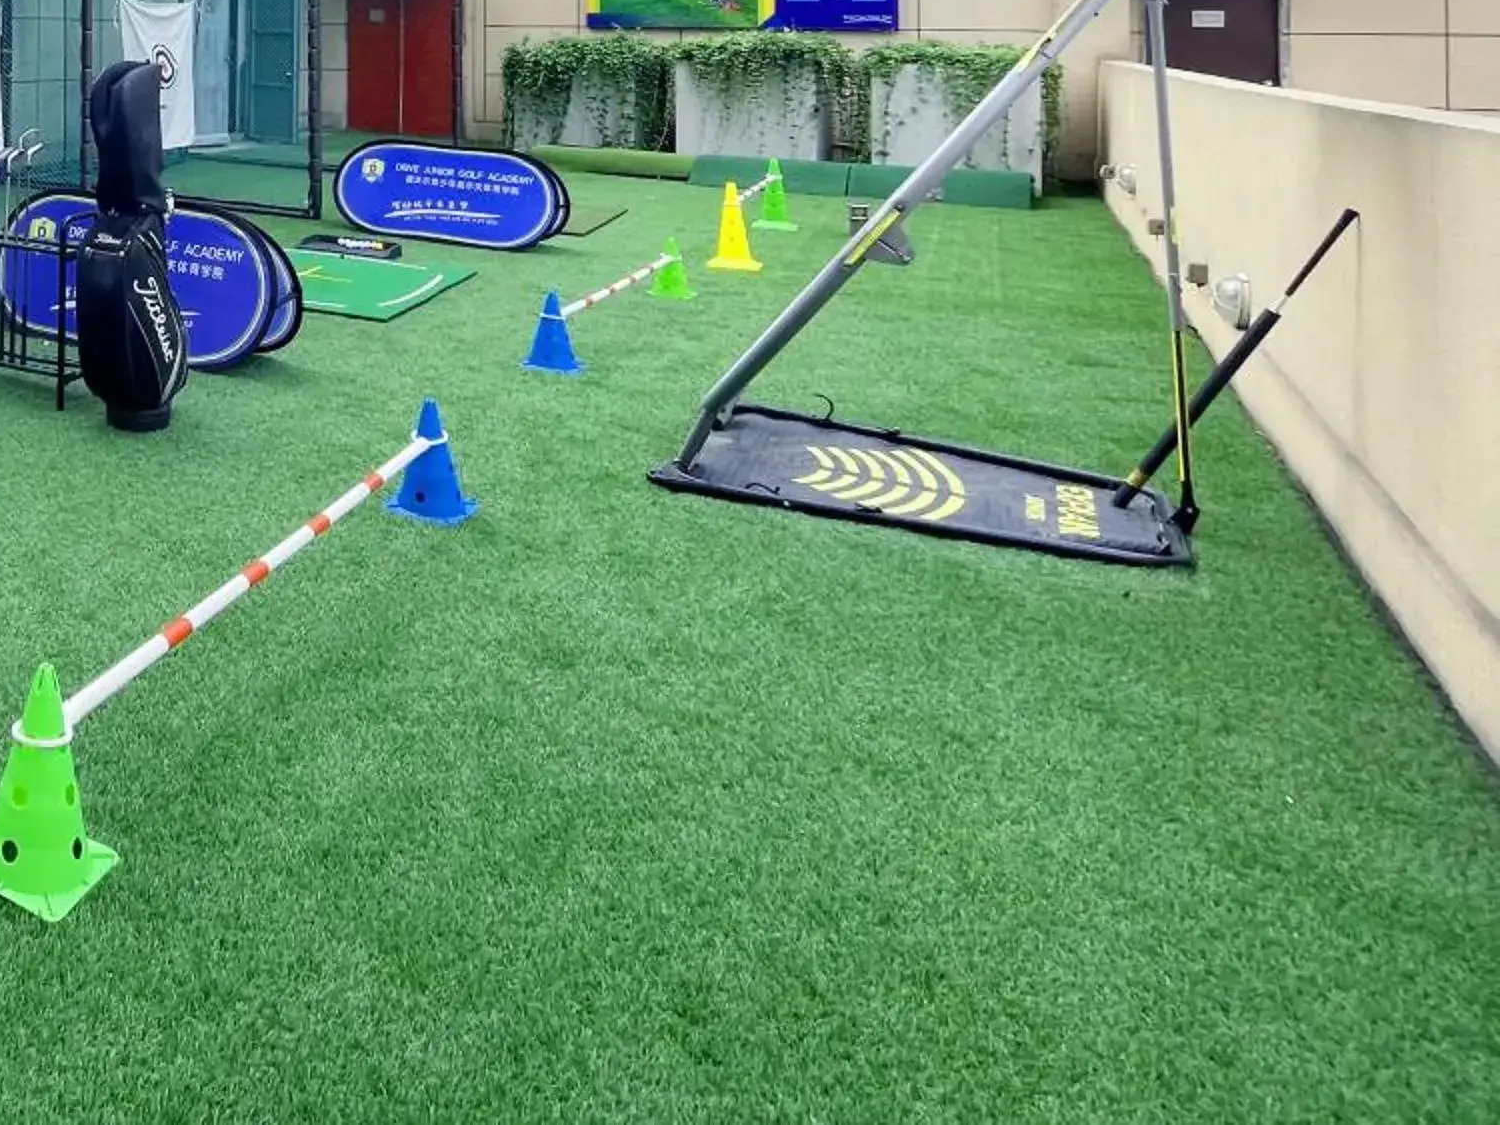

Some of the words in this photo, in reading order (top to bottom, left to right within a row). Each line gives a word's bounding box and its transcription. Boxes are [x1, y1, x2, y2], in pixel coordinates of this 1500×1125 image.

[395, 162, 420, 173] DRIVE
[423, 165, 455, 177] JUNIOR
[458, 168, 485, 180] GOLF
[487, 171, 535, 185] ACADEMY
[183, 242, 245, 264] ACADEMY
